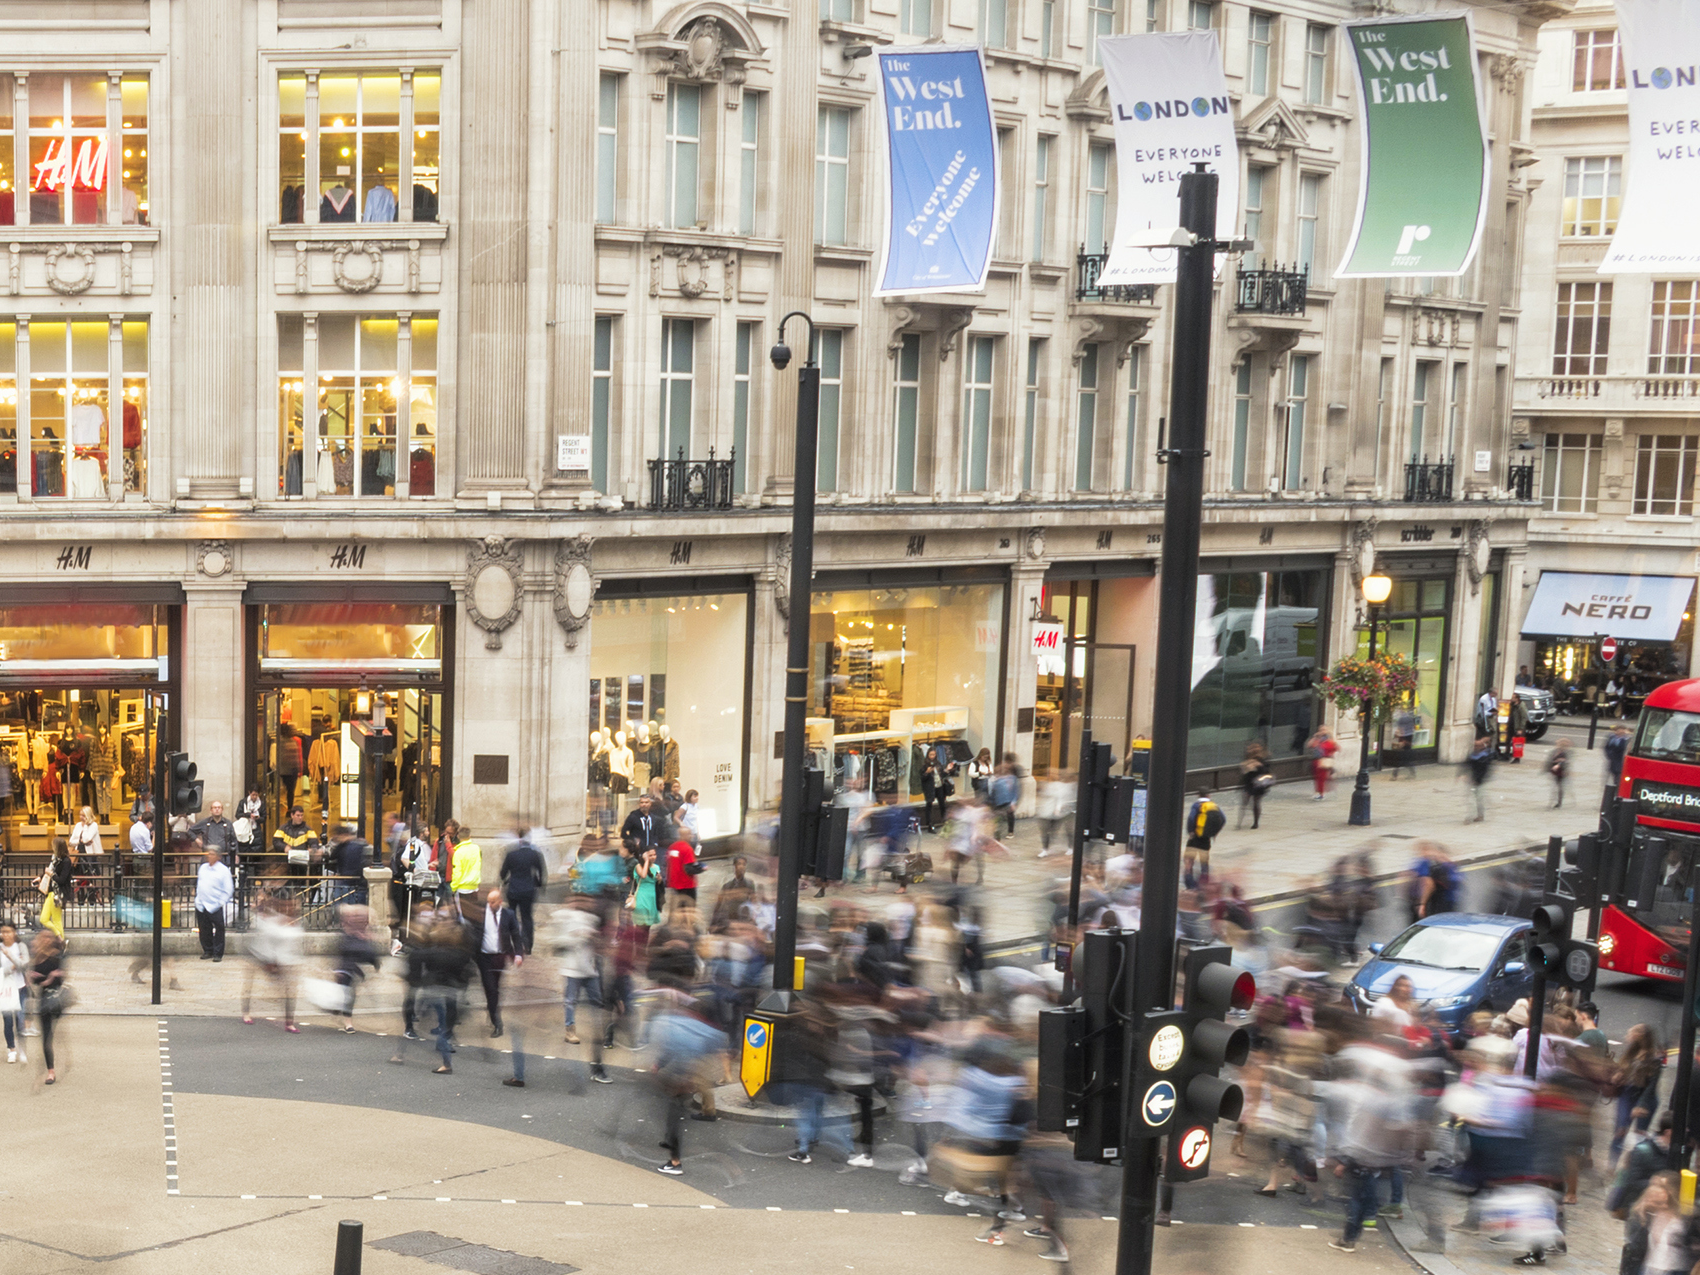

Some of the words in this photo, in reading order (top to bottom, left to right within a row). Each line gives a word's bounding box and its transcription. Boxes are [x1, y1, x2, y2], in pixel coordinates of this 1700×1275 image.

[1357, 31, 1387, 43] The
[884, 59, 910, 72] The
[1363, 45, 1452, 73] West
[889, 75, 966, 101] West
[1370, 73, 1448, 104] End.
[1632, 65, 1700, 89] LON
[893, 102, 962, 131] End.
[1117, 96, 1228, 122] LONDON
[34, 138, 108, 191] H&M
[1135, 144, 1222, 162] EVERYONE
[905, 149, 967, 238] Everyone
[922, 166, 981, 246] welcome
[906, 535, 926, 557] H&M
[1096, 530, 1113, 551] H&M
[56, 545, 93, 571] H&M
[330, 544, 367, 569] H&M
[669, 541, 693, 565] H&M
[1561, 602, 1652, 620] NERO
[1034, 630, 1059, 649] H&M
[714, 774, 733, 784] DENIM
[716, 763, 732, 773] LOVE
[1640, 789, 1683, 805] Deptford
[1158, 1032, 1181, 1042] Except
